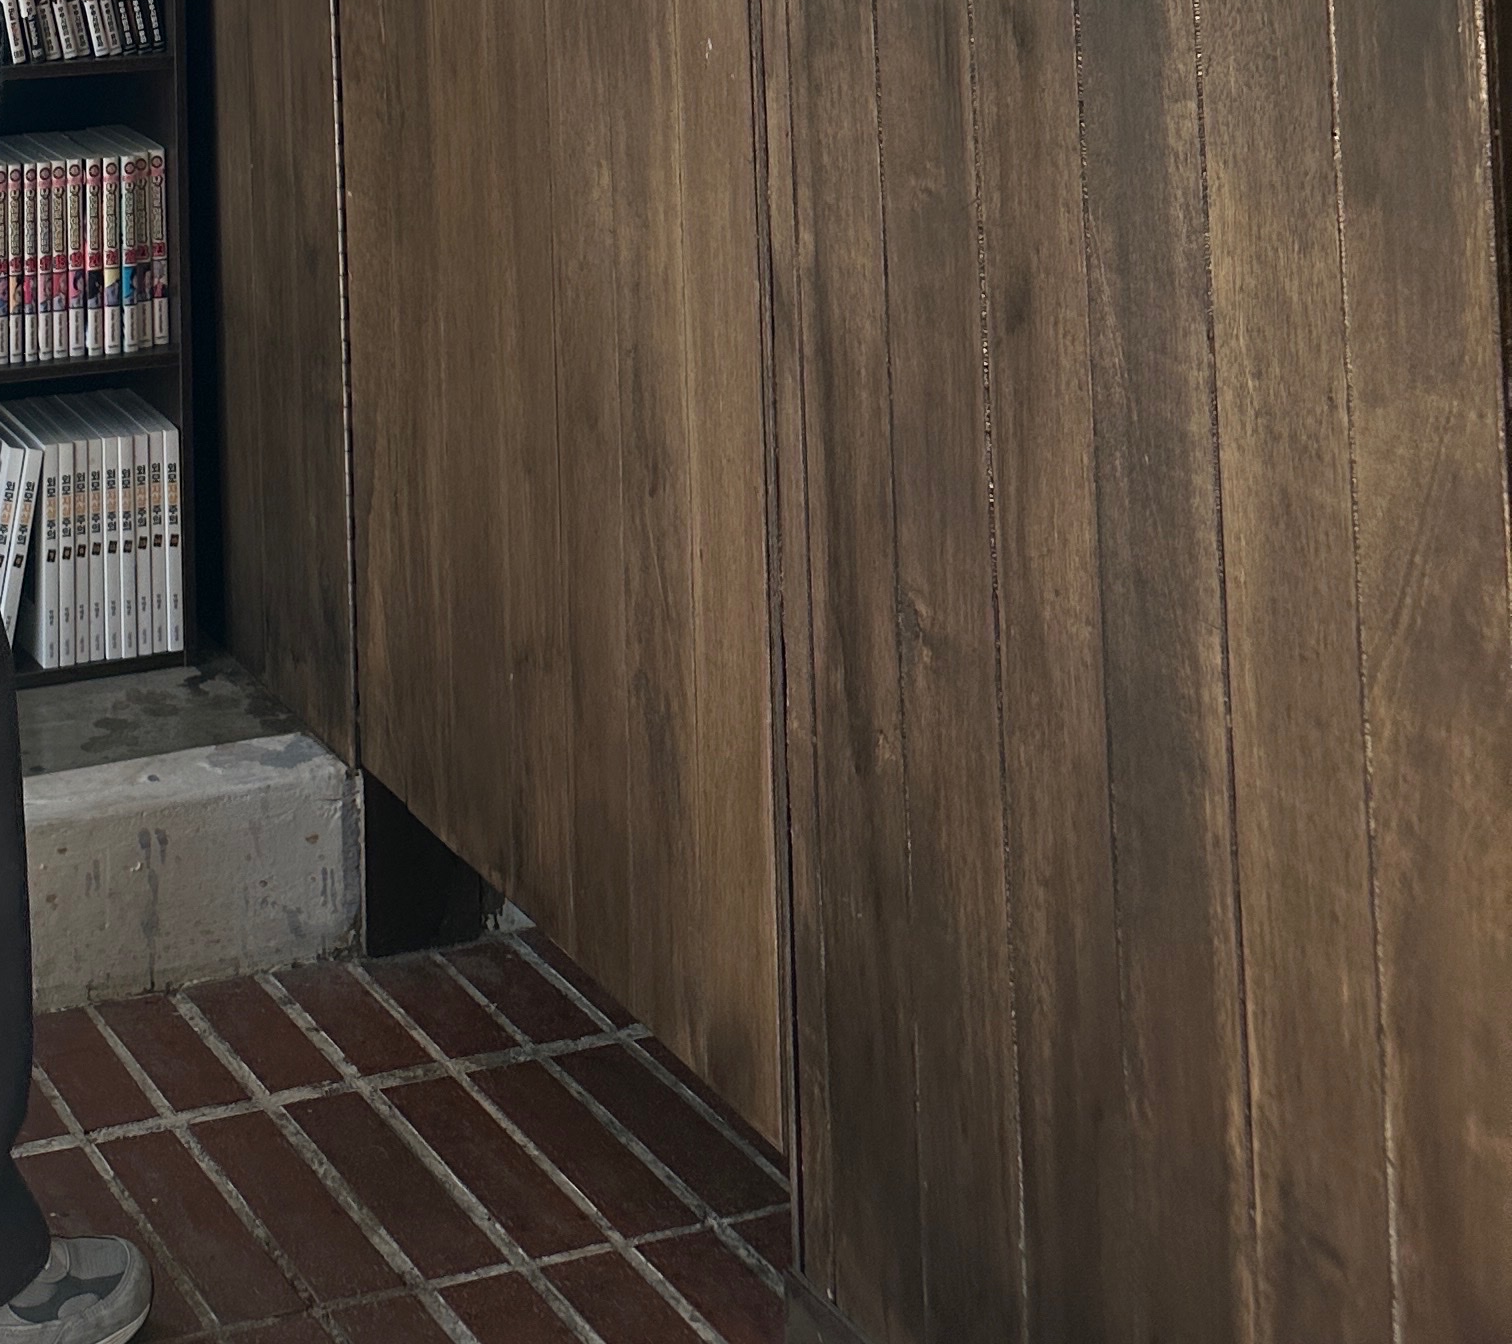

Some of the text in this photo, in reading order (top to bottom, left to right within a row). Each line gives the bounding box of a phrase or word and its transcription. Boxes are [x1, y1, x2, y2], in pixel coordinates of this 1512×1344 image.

[17, 481, 35, 545] 외모지상주의
[47, 477, 56, 540] 외모지상주의
[62, 475, 71, 537] 외모지상주의
[76, 473, 86, 535] 외모지상주의
[91, 470, 100, 533] 외모지상주의
[107, 469, 116, 531] 외모지상주의
[122, 469, 132, 531] 외모지상주의
[137, 465, 147, 527] 외모지상주의
[151, 463, 161, 525] 외모지상주의
[168, 463, 178, 525] 외모지상주의
